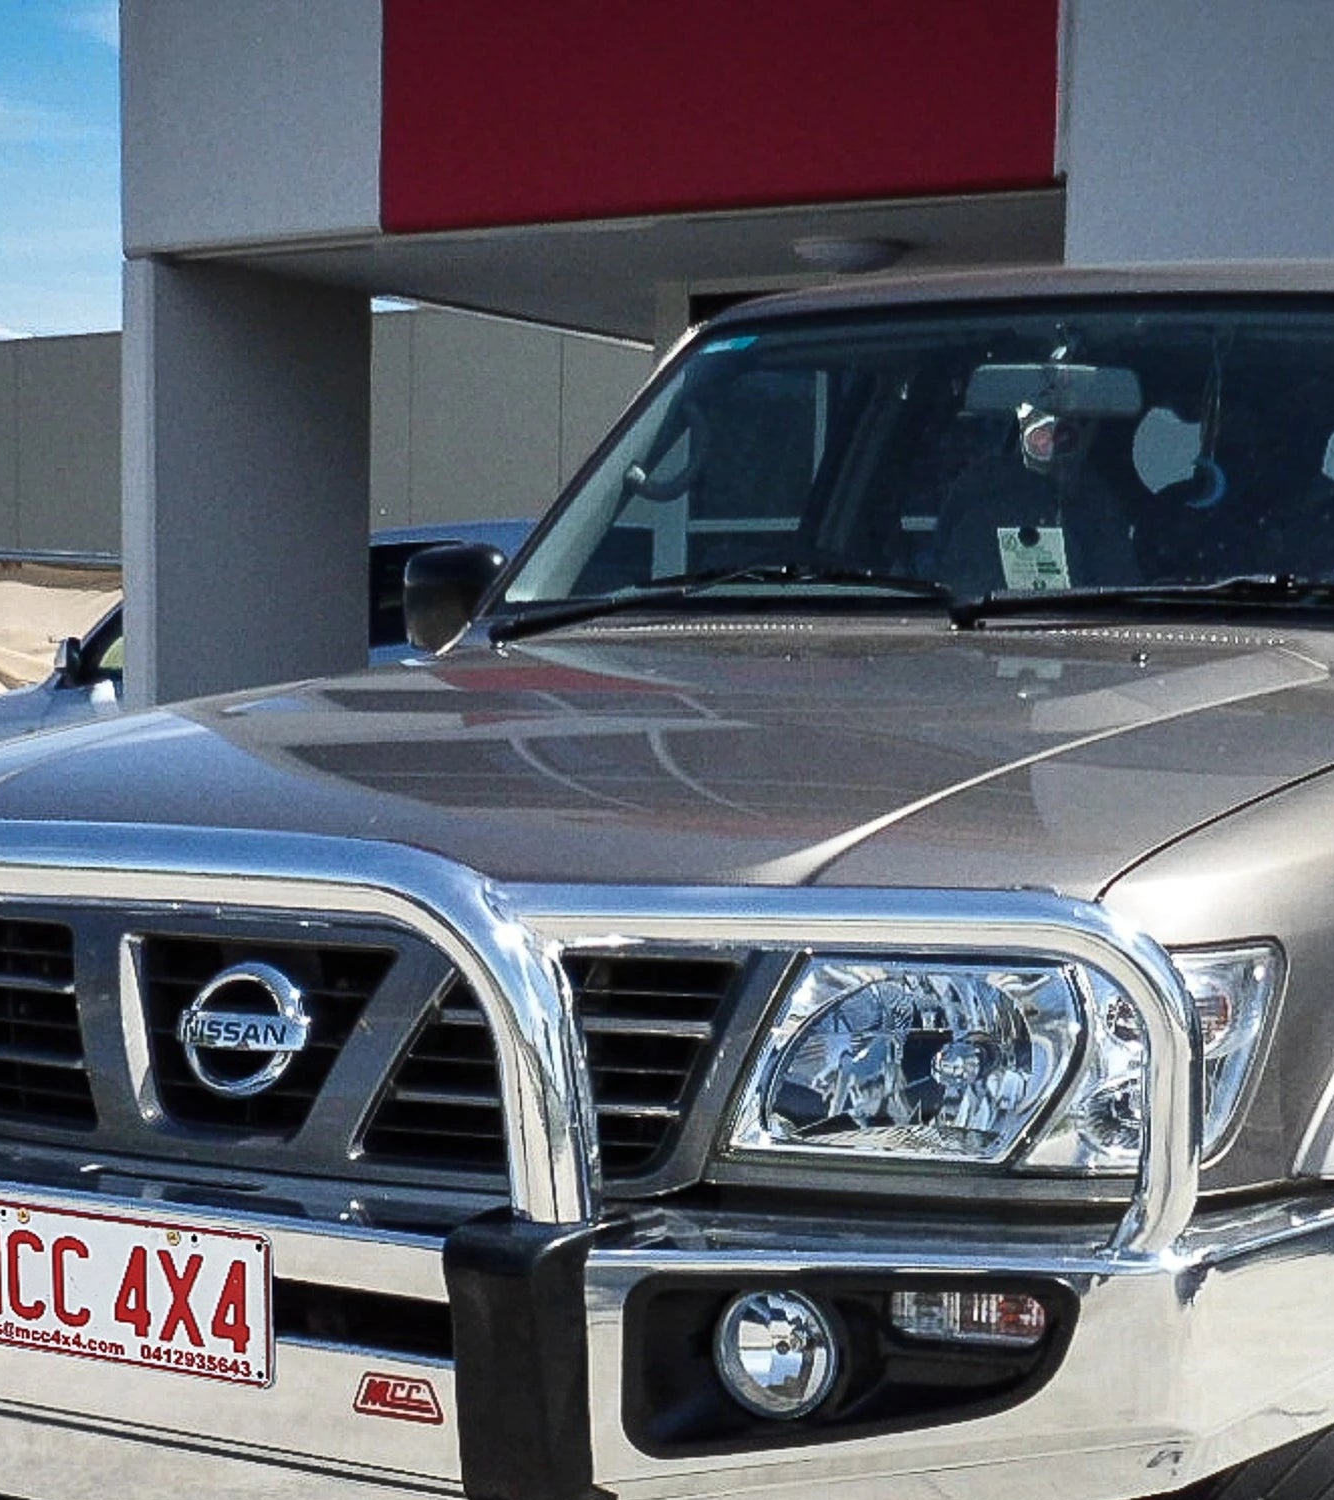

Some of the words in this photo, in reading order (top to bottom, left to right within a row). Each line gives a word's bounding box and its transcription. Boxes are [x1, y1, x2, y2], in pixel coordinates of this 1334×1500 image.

[185, 1019, 287, 1044] NISSAN
[114, 1245, 250, 1354] 4X4
[140, 1344, 252, 1378] 0412935643
[360, 1378, 434, 1413] MCC
